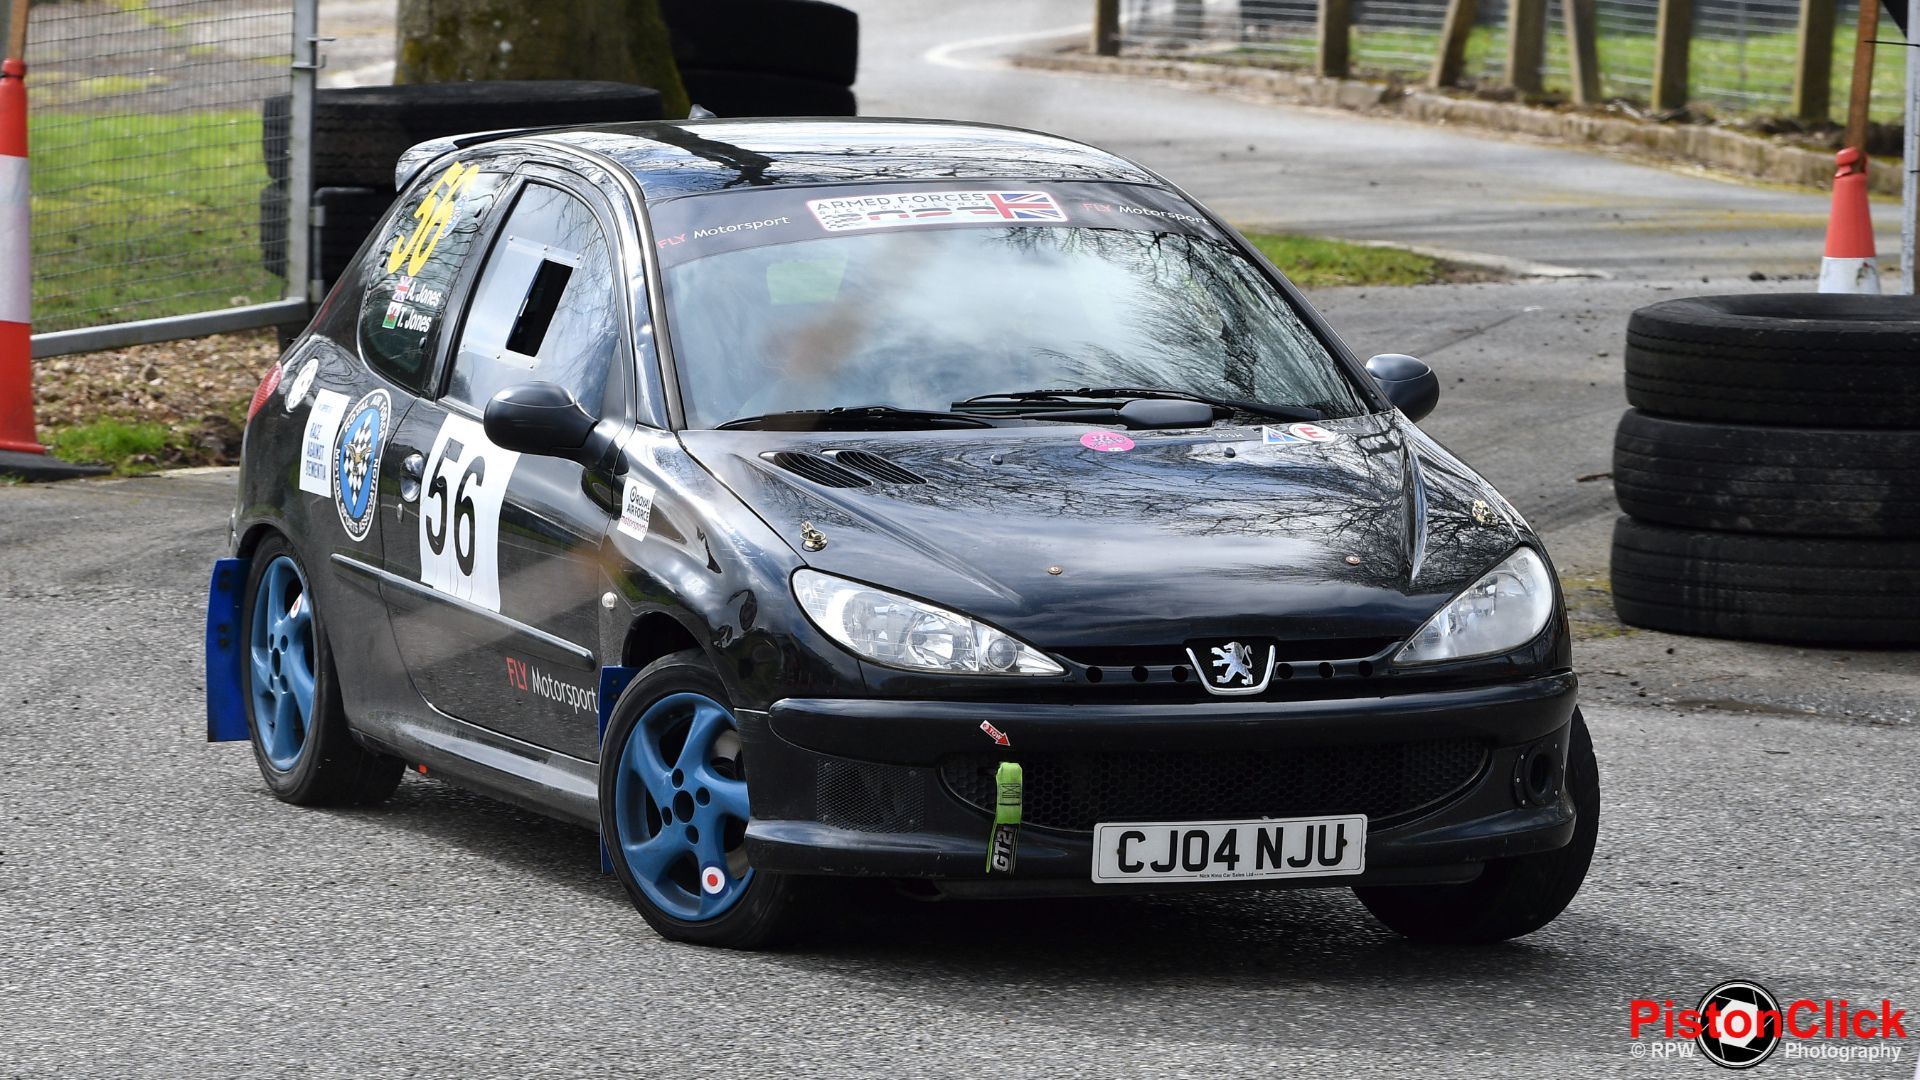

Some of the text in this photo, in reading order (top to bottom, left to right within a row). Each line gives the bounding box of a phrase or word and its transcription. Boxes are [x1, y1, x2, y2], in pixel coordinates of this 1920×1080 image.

[817, 193, 986, 210] ARMED FORCES
[881, 200, 991, 210] CHALLENGE
[387, 161, 479, 276] 56
[1082, 202, 1209, 226] FLY Motorsport
[657, 216, 790, 249] FLY Motorsport
[416, 283, 441, 307] Jones
[404, 308, 432, 333] Jones
[344, 399, 369, 433] ROYAL
[378, 401, 388, 441] FORCE
[1297, 427, 1327, 439] E
[425, 437, 485, 576] 56
[636, 494, 650, 510] ROYAL
[506, 657, 600, 715] FLY Motorsport
[989, 727, 1003, 740] TOW
[1117, 823, 1346, 873] CJ04 NJU
